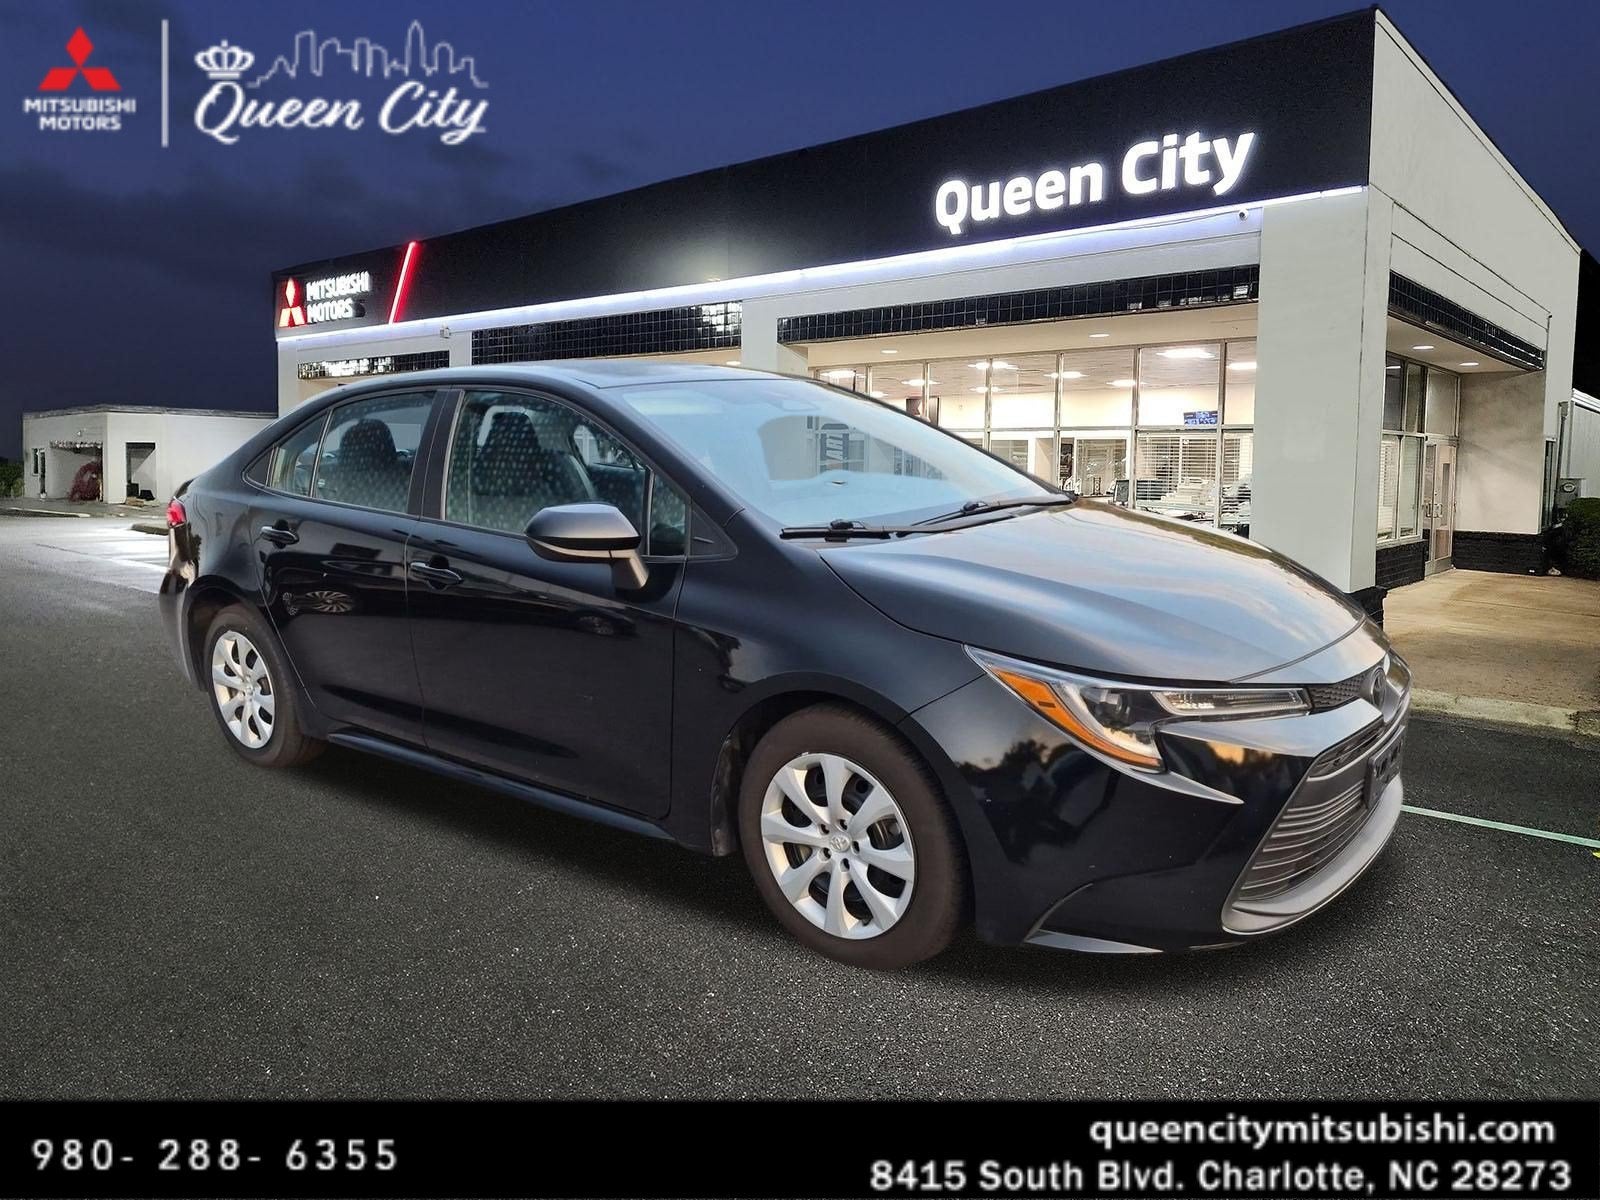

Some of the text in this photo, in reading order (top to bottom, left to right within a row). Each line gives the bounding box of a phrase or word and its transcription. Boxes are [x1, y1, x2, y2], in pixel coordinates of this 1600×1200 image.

[935, 131, 1255, 234] Queen City
[305, 271, 370, 301] MITSUBISHI
[306, 298, 354, 324] MOTORS
